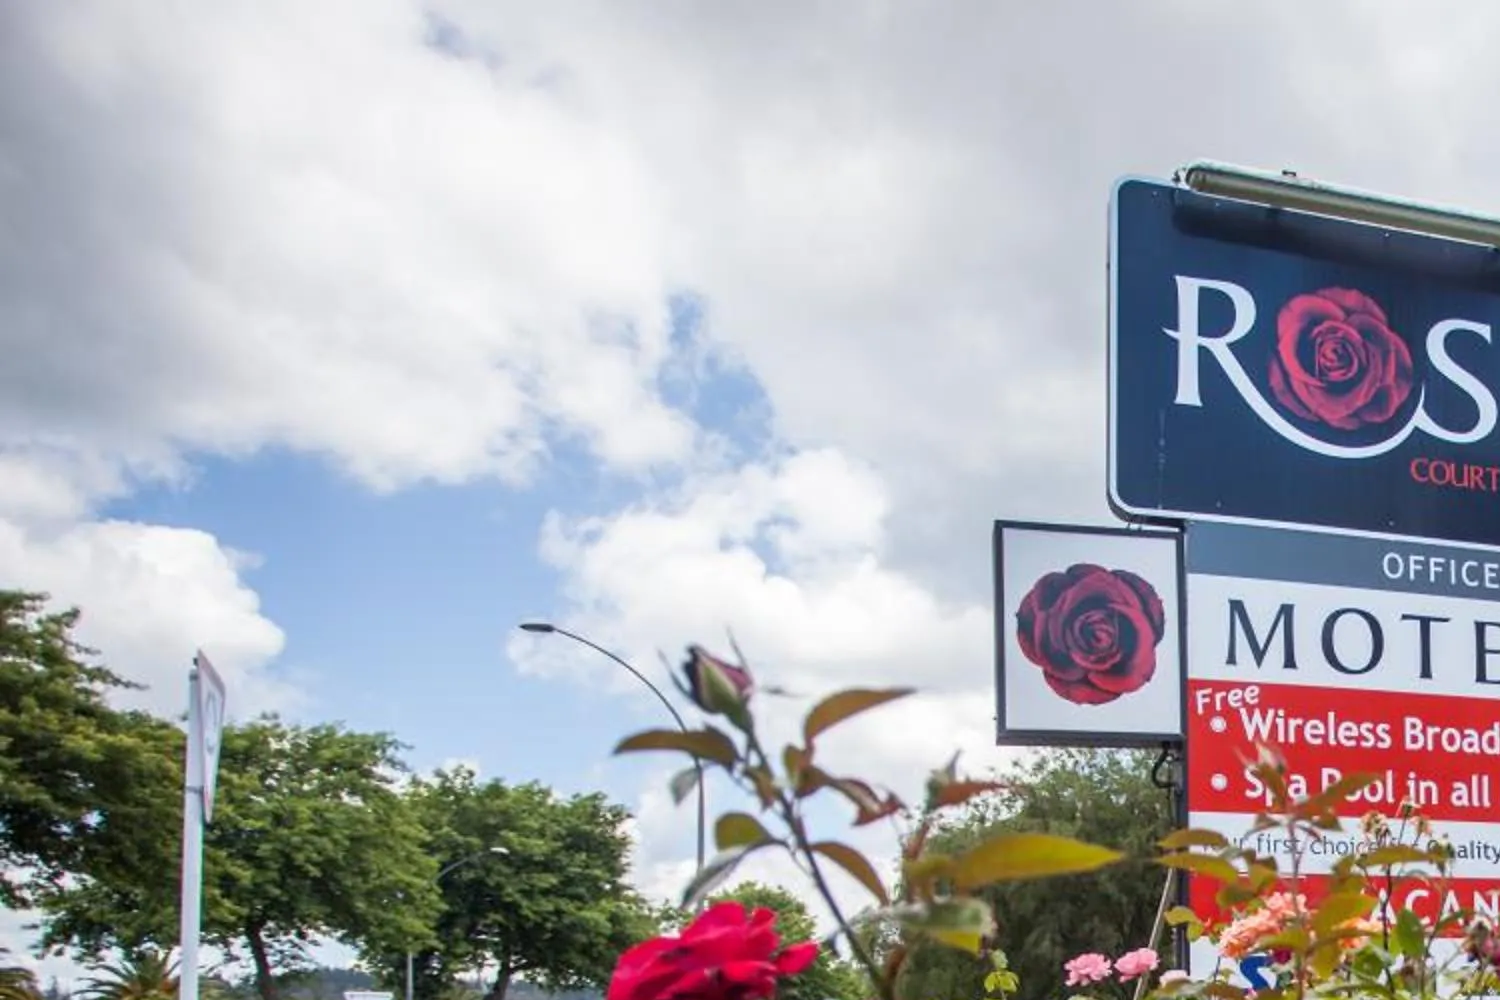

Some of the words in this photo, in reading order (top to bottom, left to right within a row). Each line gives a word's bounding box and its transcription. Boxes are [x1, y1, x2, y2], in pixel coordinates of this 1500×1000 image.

[1382, 552, 1500, 589] OFFICE
[1195, 685, 1260, 715] Free
[1239, 708, 1392, 749] Wireless
[1407, 772, 1438, 805] in
[1451, 774, 1491, 808] all
[1257, 833, 1301, 854] first
